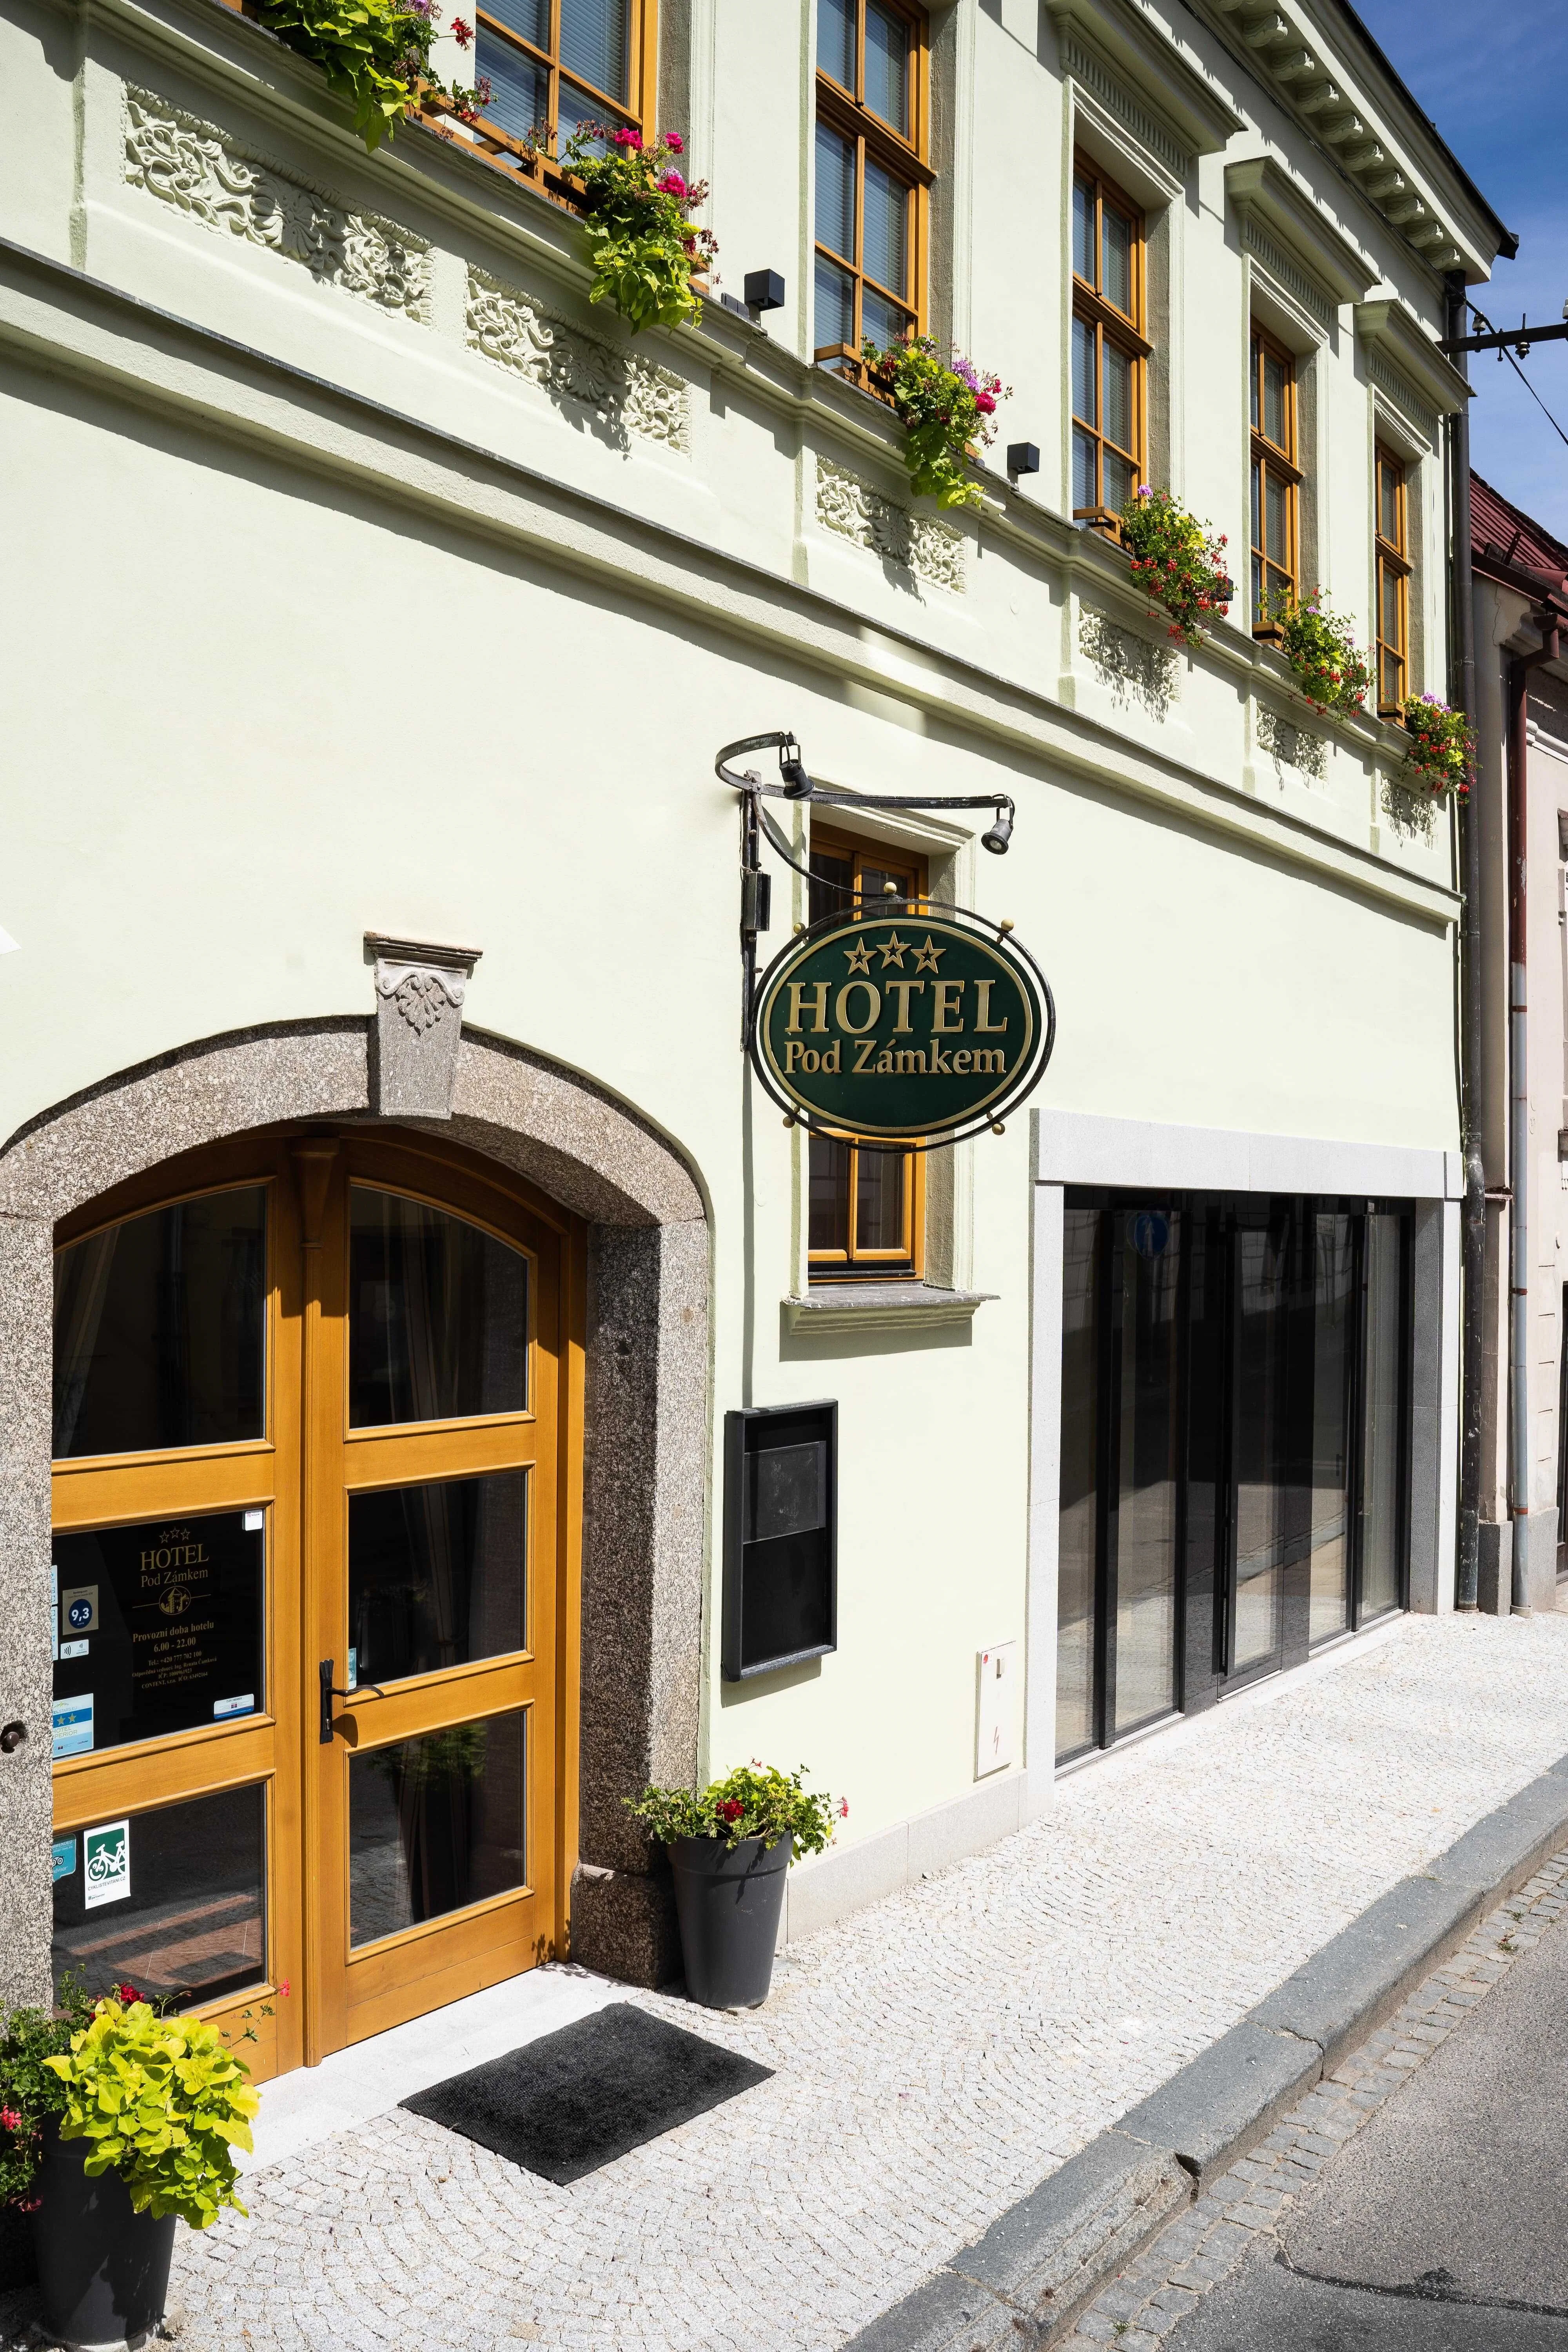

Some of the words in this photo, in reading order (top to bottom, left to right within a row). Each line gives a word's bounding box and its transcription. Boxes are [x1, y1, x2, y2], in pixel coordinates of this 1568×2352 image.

[785, 980, 1008, 1034] HOTEL
[784, 1039, 842, 1074] Pod
[852, 1038, 1007, 1075] Zámkem
[140, 1544, 210, 1571] HOTEL
[141, 1573, 160, 1587] Pod
[164, 1568, 209, 1584] Zámkem
[72, 1608, 89, 1622] 9,3
[133, 1628, 168, 1642] Provozní
[170, 1625, 189, 1636] doba
[191, 1620, 214, 1632] hotelu
[154, 1642, 169, 1652] 6.00
[176, 1637, 196, 1648] 22.00
[53, 1730, 78, 1739] PERIOR
[88, 1876, 126, 1891] CYKLISTEVITANI.CZ
